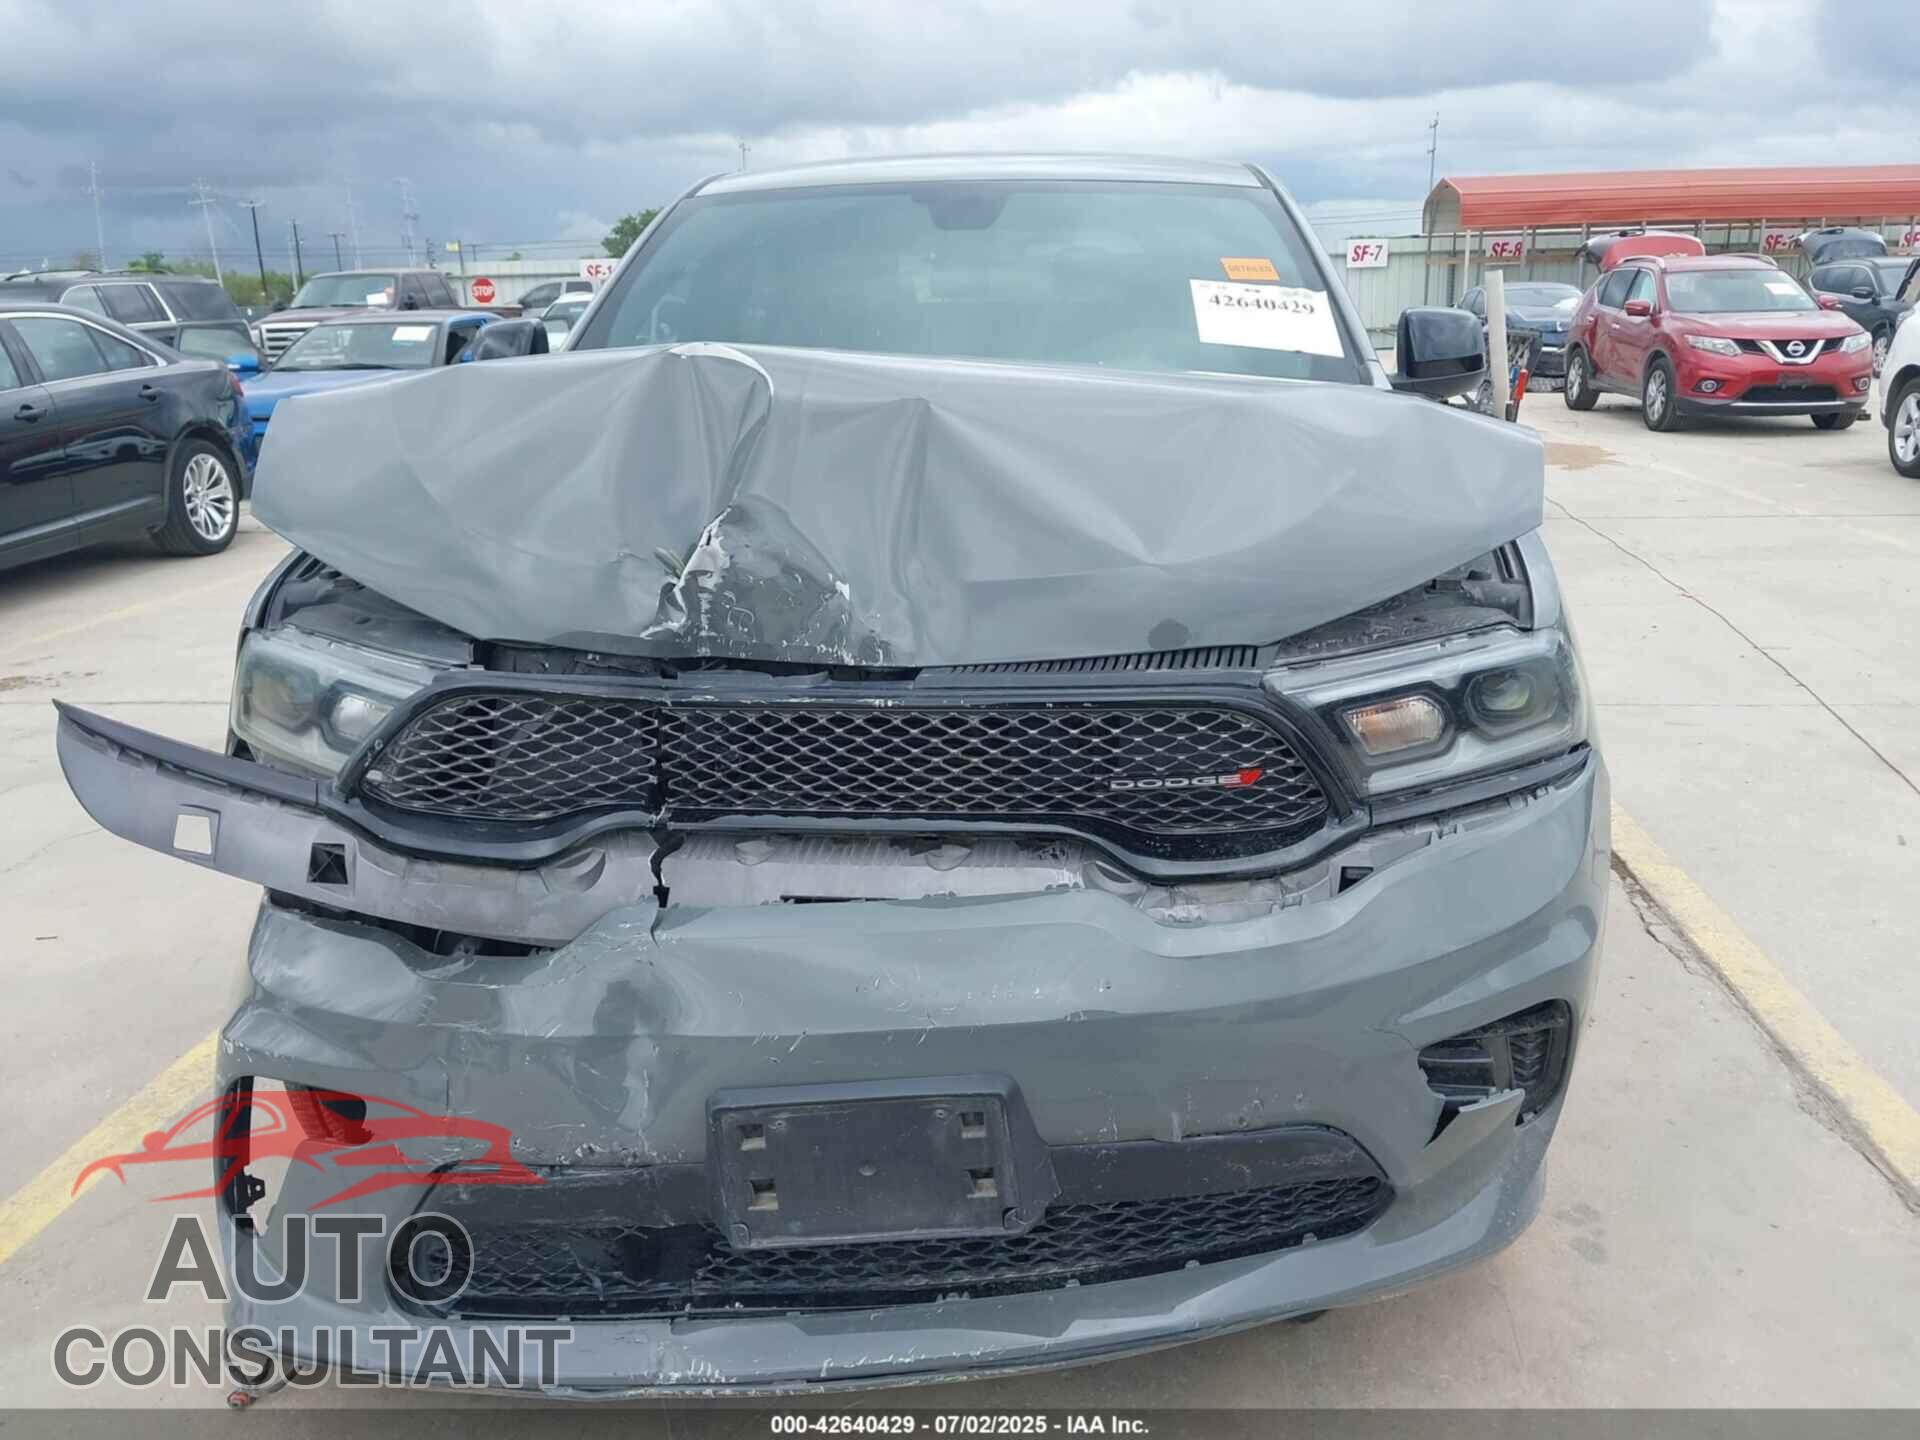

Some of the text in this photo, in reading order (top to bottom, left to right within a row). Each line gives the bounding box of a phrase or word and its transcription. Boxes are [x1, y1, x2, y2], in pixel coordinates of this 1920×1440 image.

[1351, 244, 1383, 262] SF-7
[1490, 241, 1523, 257] SF-8
[472, 286, 495, 296] STOP
[1209, 294, 1315, 315] 42640429
[1110, 774, 1241, 790] DODGE
